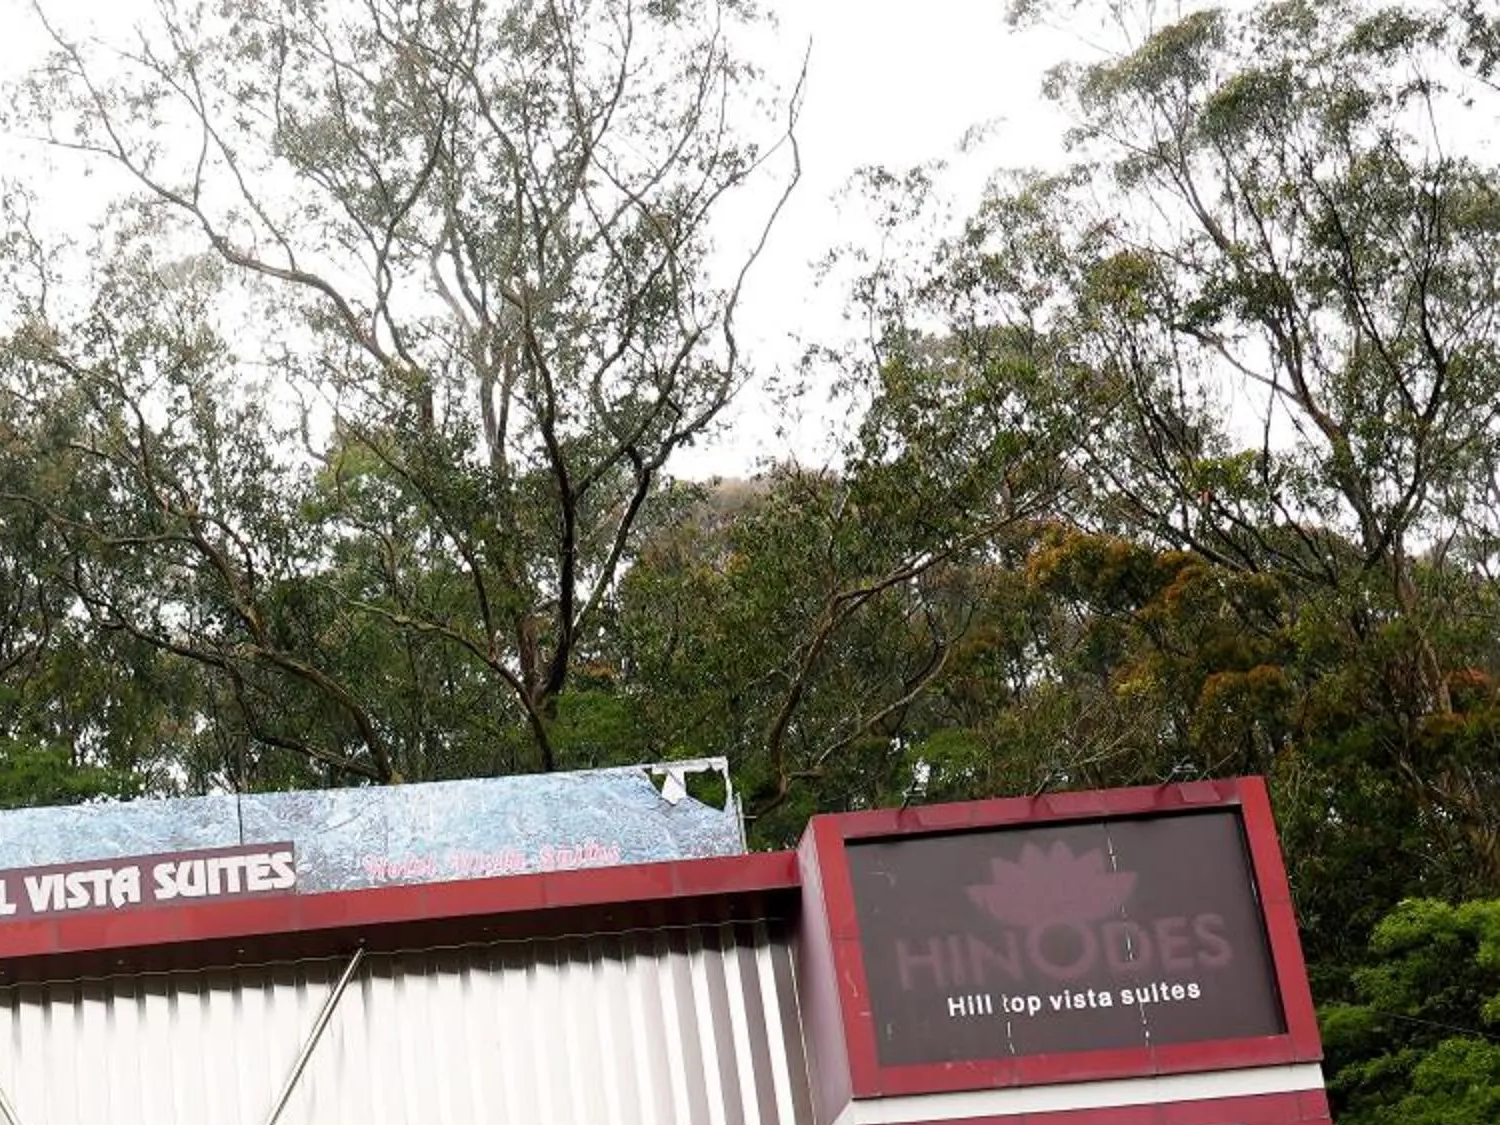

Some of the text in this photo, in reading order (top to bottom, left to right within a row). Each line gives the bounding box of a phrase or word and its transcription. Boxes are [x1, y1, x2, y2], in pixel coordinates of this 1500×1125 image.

[24, 866, 141, 910] VISTA
[153, 852, 298, 900] SUITES
[897, 912, 1233, 991] HINODES
[947, 994, 994, 1017] Hill
[1049, 988, 1113, 1012] vista
[1121, 981, 1202, 1006] suites
